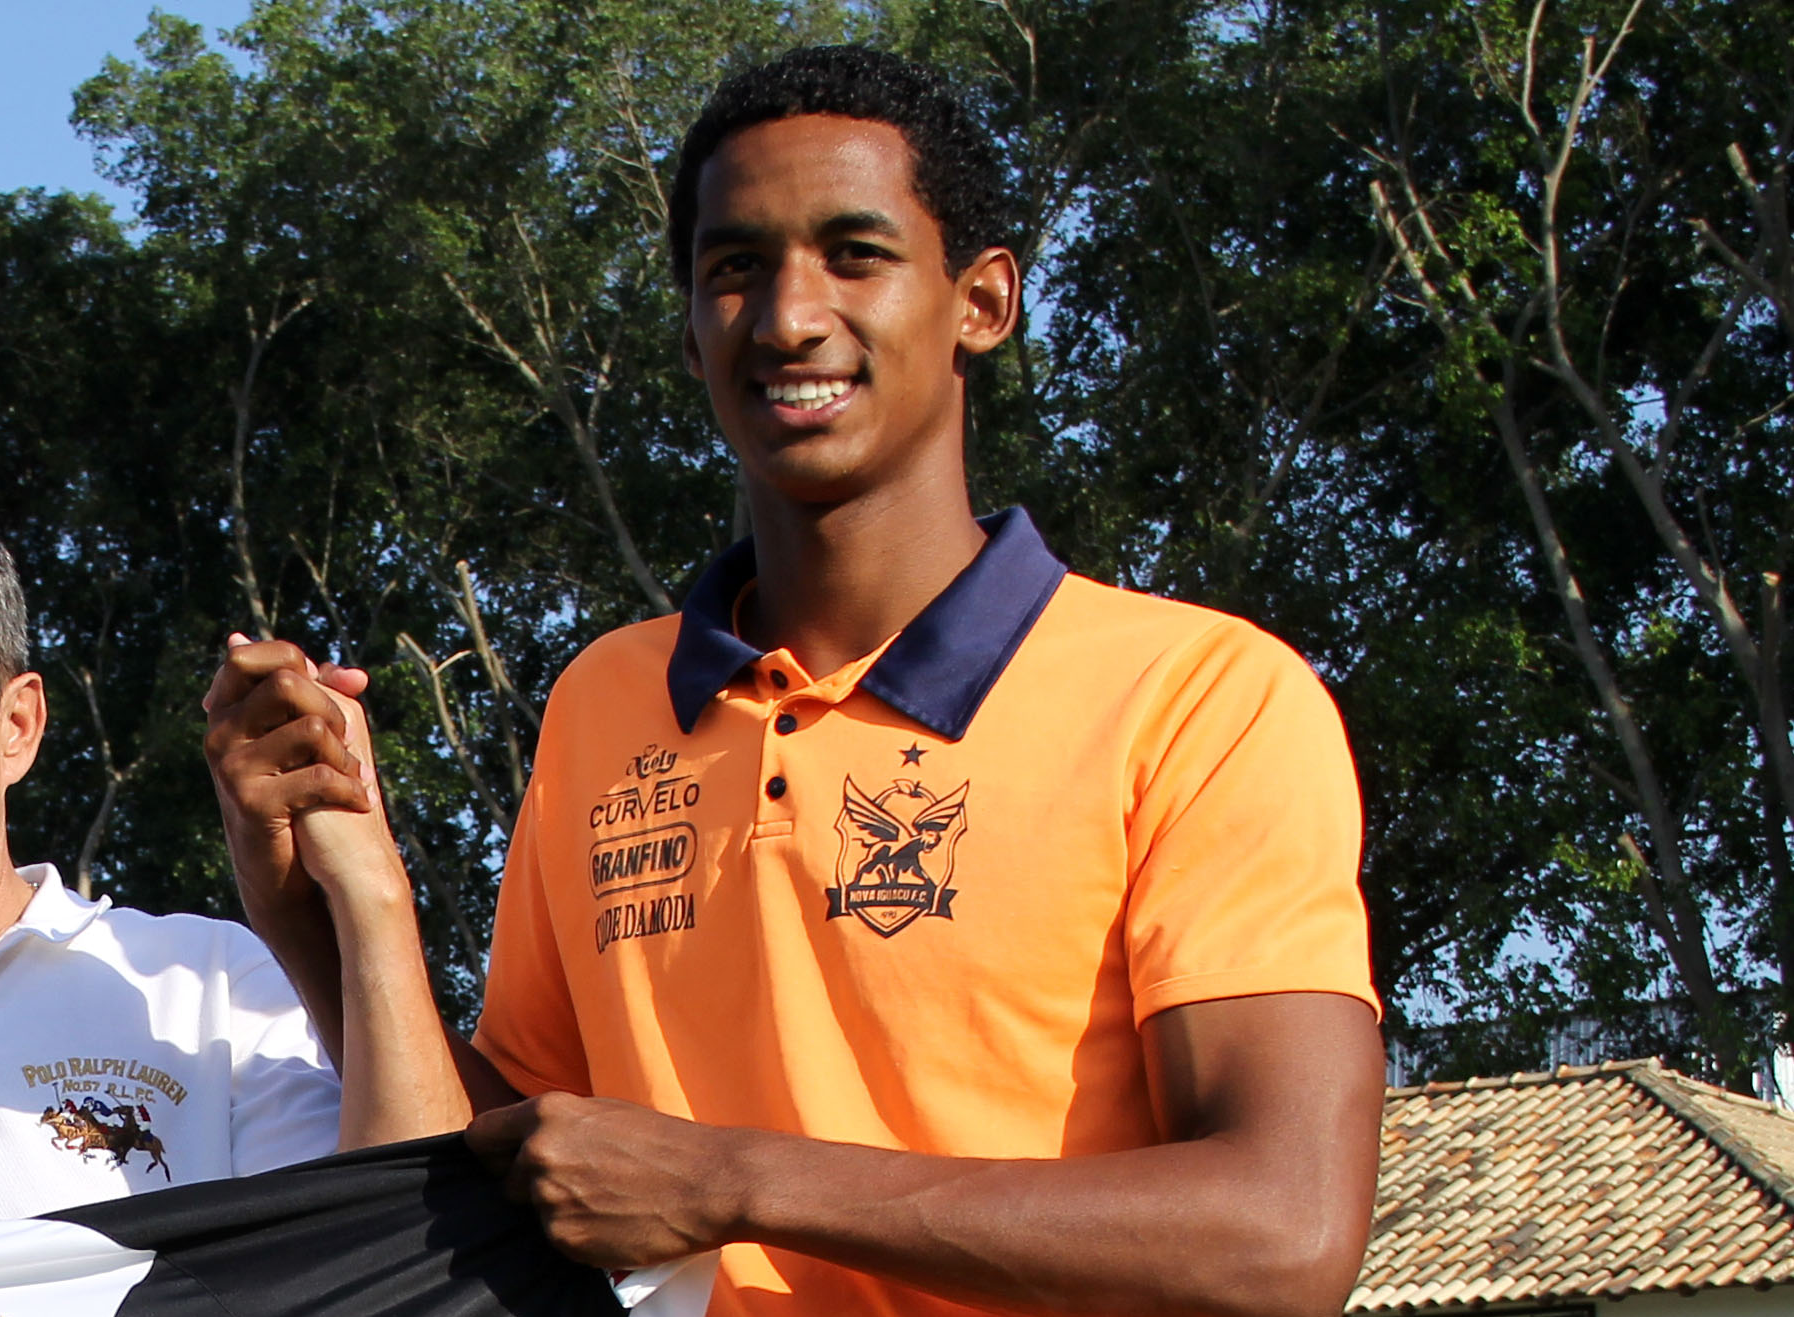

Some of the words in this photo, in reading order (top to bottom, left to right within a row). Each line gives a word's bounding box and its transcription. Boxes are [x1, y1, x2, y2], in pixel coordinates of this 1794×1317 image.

[626, 744, 678, 779] Niely
[590, 775, 700, 829] CURVELO
[592, 835, 688, 887] GRANFINO
[622, 901, 646, 940] DA
[646, 893, 695, 935] MODA
[849, 889, 876, 903] NOVA
[22, 1060, 67, 1088] POLO
[67, 1057, 126, 1078] RALPH
[125, 1058, 188, 1106] LAUREN
